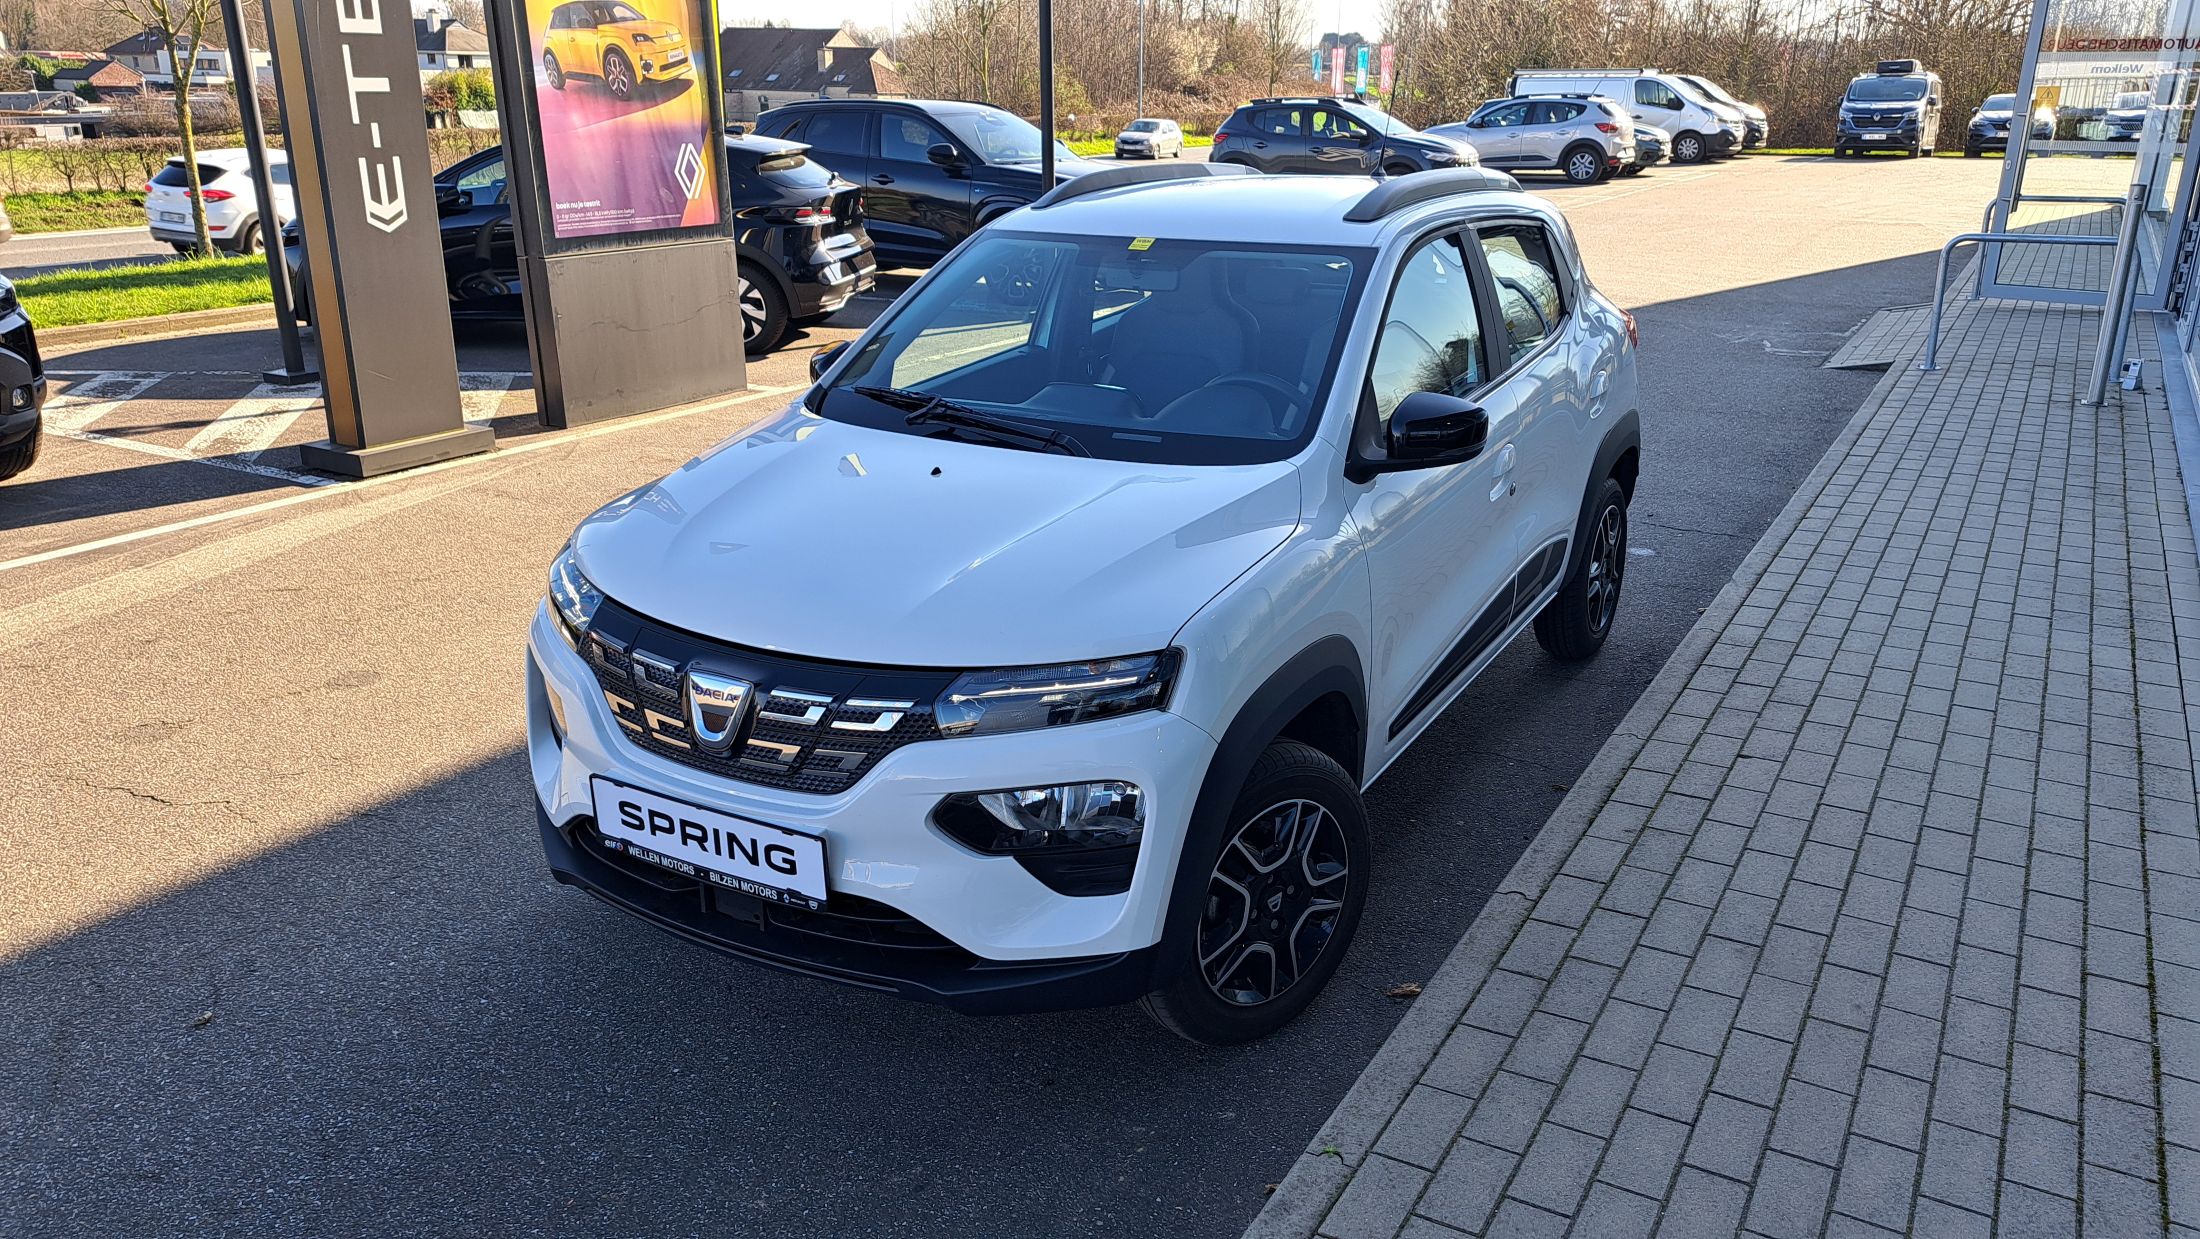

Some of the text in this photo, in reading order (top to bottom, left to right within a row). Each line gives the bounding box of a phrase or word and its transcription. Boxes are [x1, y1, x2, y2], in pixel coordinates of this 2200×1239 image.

[695, 685, 735, 703] DACIA
[618, 800, 798, 876] SPRING
[627, 845, 660, 864] WELLEN
[661, 856, 695, 875] MOTORS
[709, 872, 739, 889] BILZEN
[740, 881, 778, 900] MOTORS
